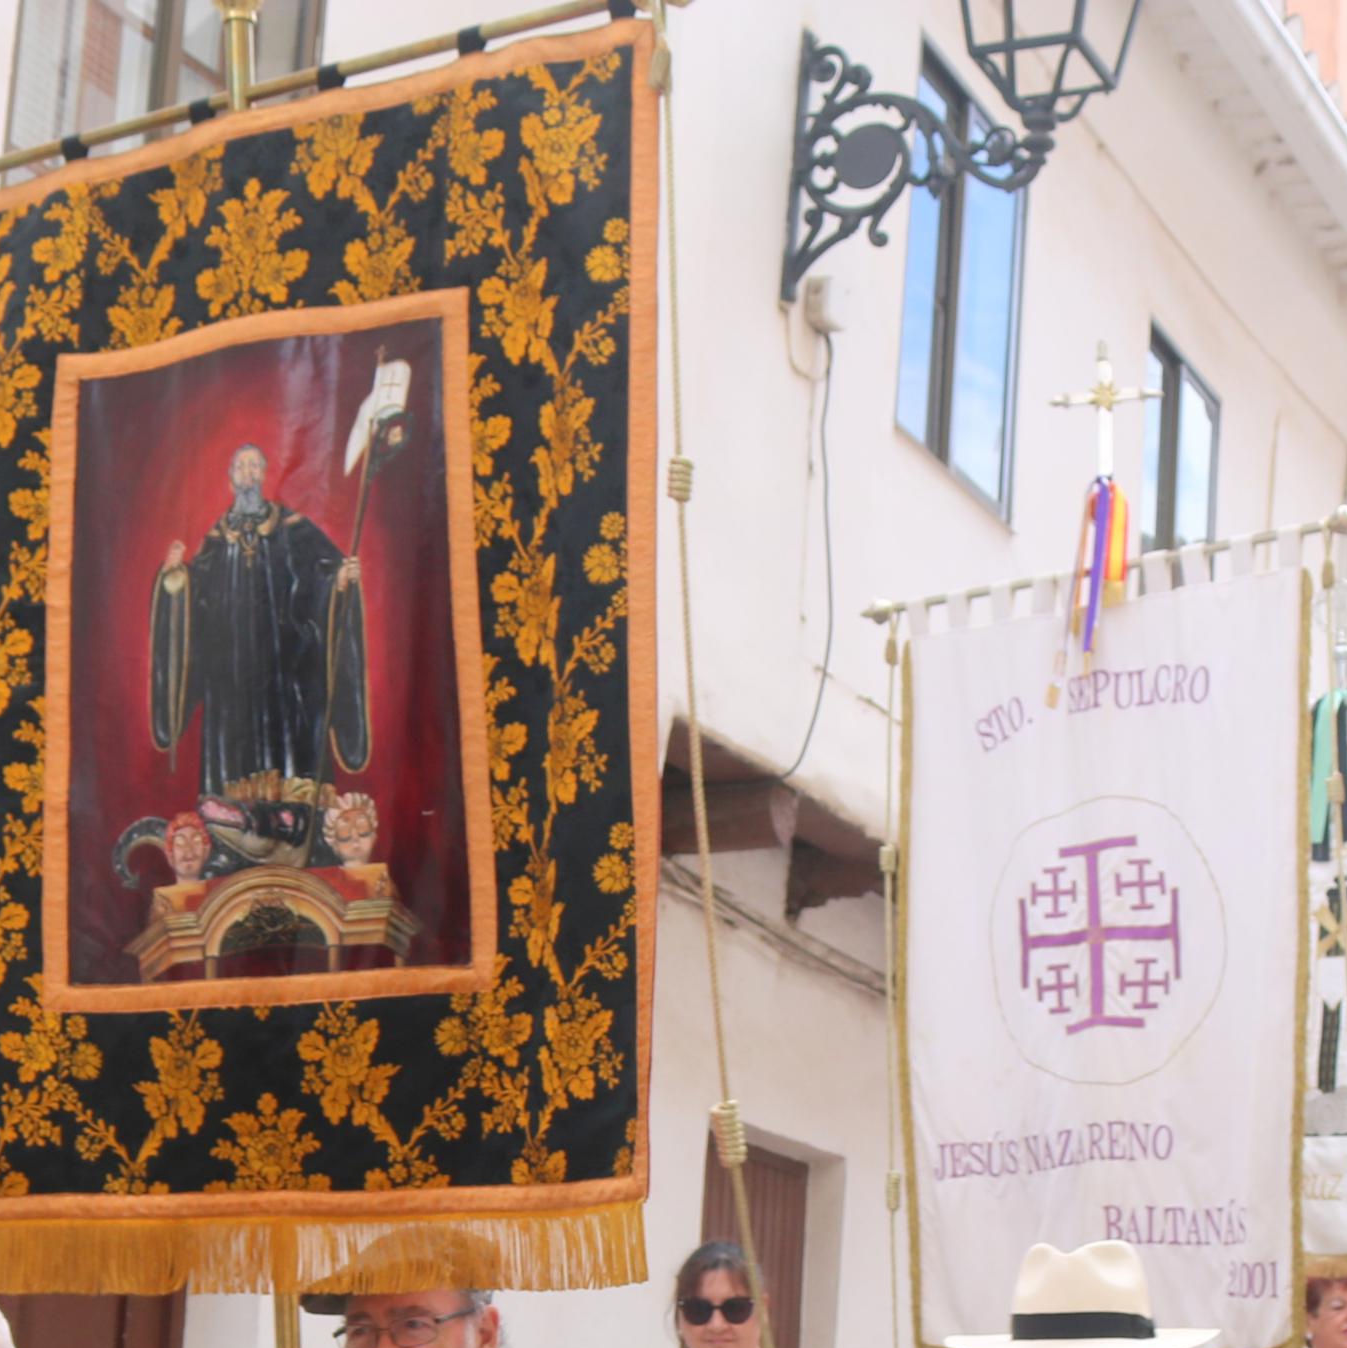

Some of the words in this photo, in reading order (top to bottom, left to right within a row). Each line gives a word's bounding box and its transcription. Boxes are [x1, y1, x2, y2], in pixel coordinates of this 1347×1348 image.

[974, 695, 1034, 754] STO.
[1067, 662, 1212, 715] SEPULCRO
[934, 1131, 1020, 1182] JESÚS
[1024, 1119, 1174, 1176] NAZARENO
[1102, 1199, 1249, 1247] BALTANÁS
[1226, 1261, 1279, 1300] 2001
